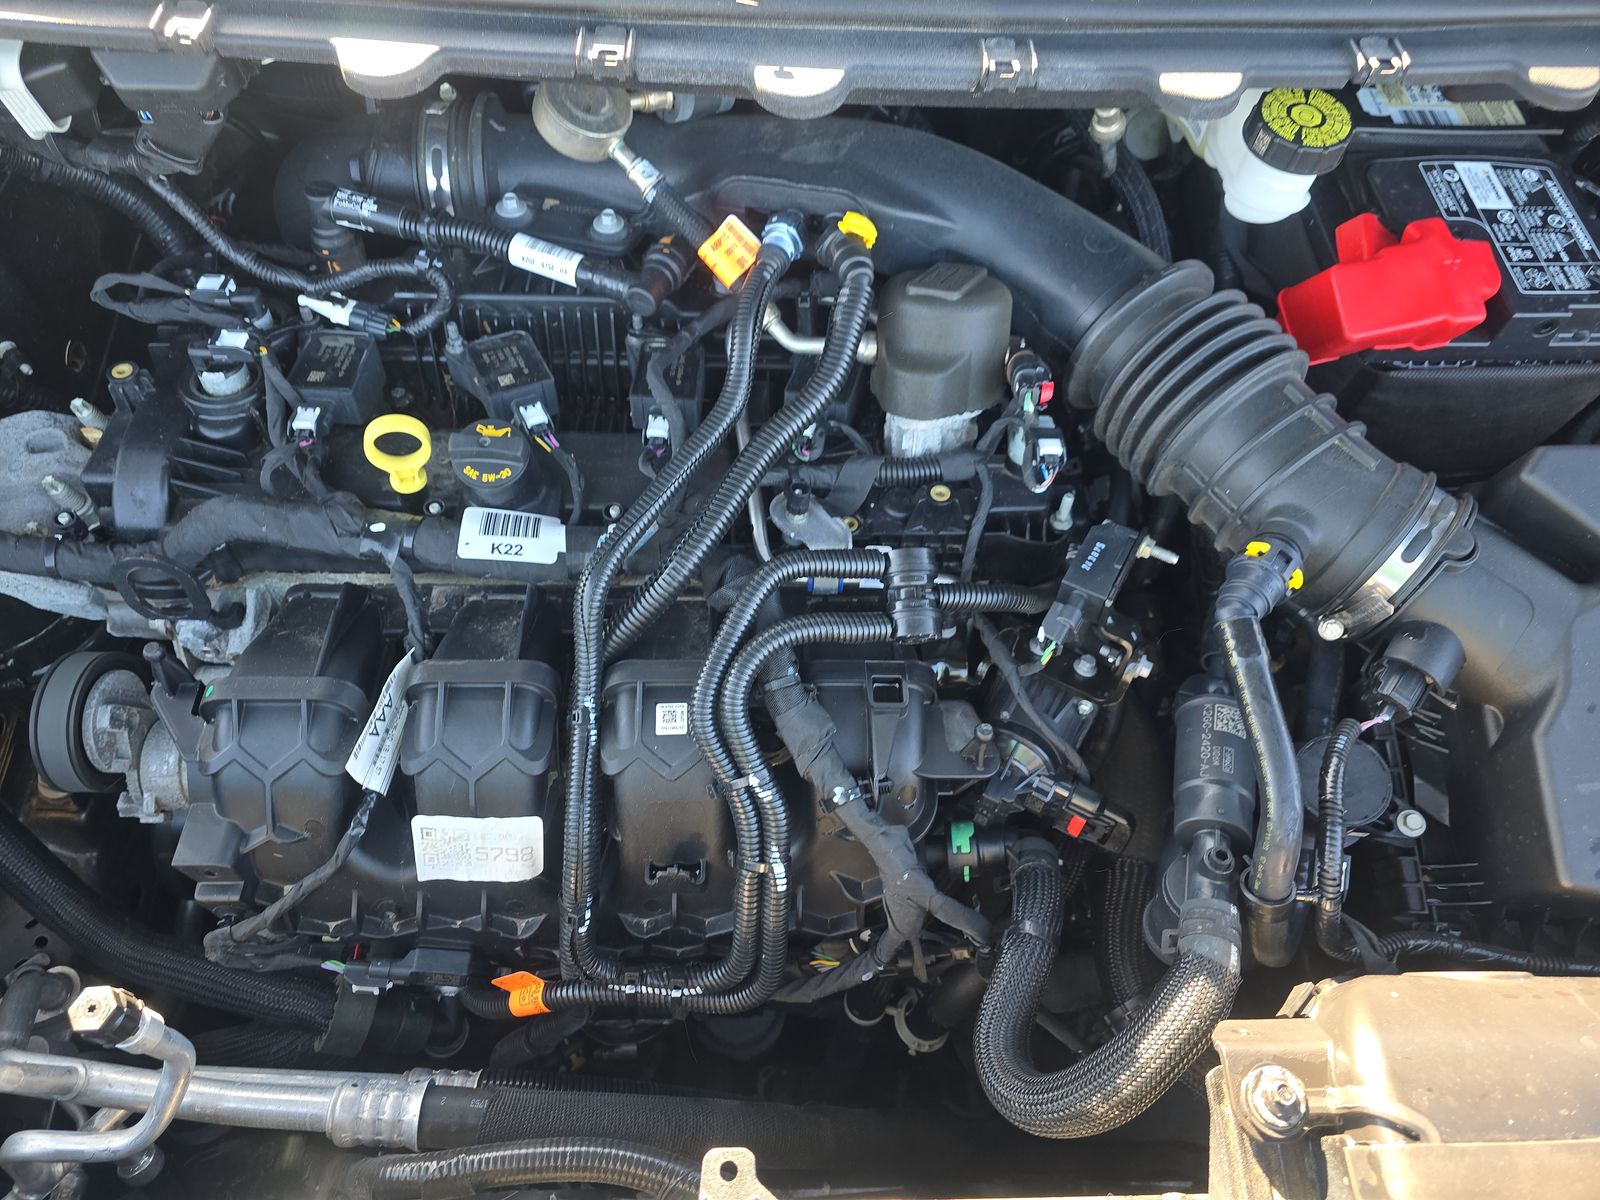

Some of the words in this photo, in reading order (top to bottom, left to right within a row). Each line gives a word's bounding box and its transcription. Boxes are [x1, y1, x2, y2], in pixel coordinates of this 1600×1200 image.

[463, 465, 479, 480] SAE
[491, 543, 524, 556] K22
[369, 692, 393, 736] AAA
[475, 846, 534, 862] 5798
